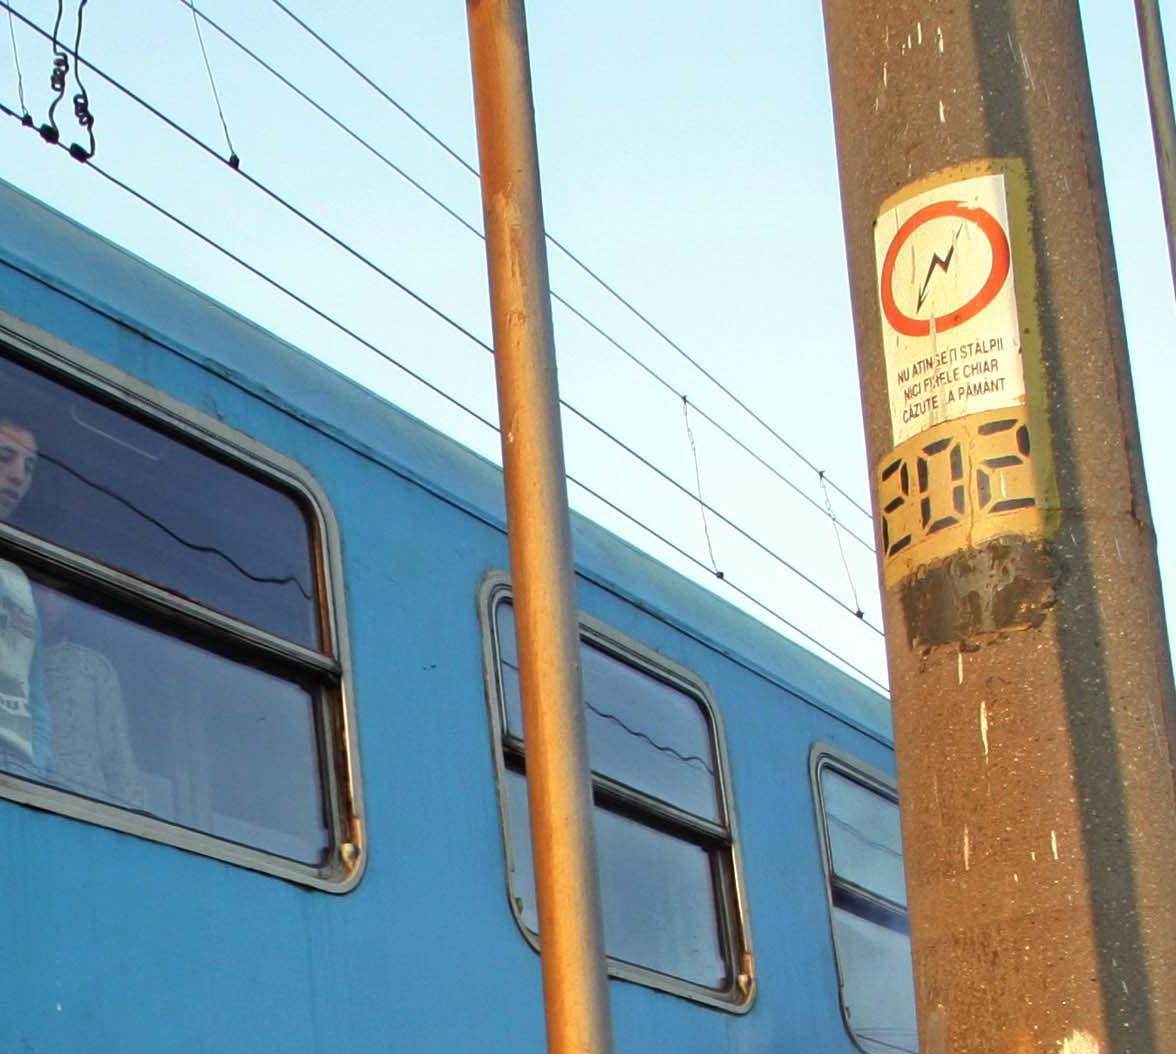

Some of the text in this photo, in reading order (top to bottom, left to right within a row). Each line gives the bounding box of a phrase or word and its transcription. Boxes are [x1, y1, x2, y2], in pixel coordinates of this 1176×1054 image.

[897, 370, 910, 386] NU
[904, 382, 922, 402] NICI
[962, 358, 999, 379] CHIAR
[881, 418, 1036, 559] 202
